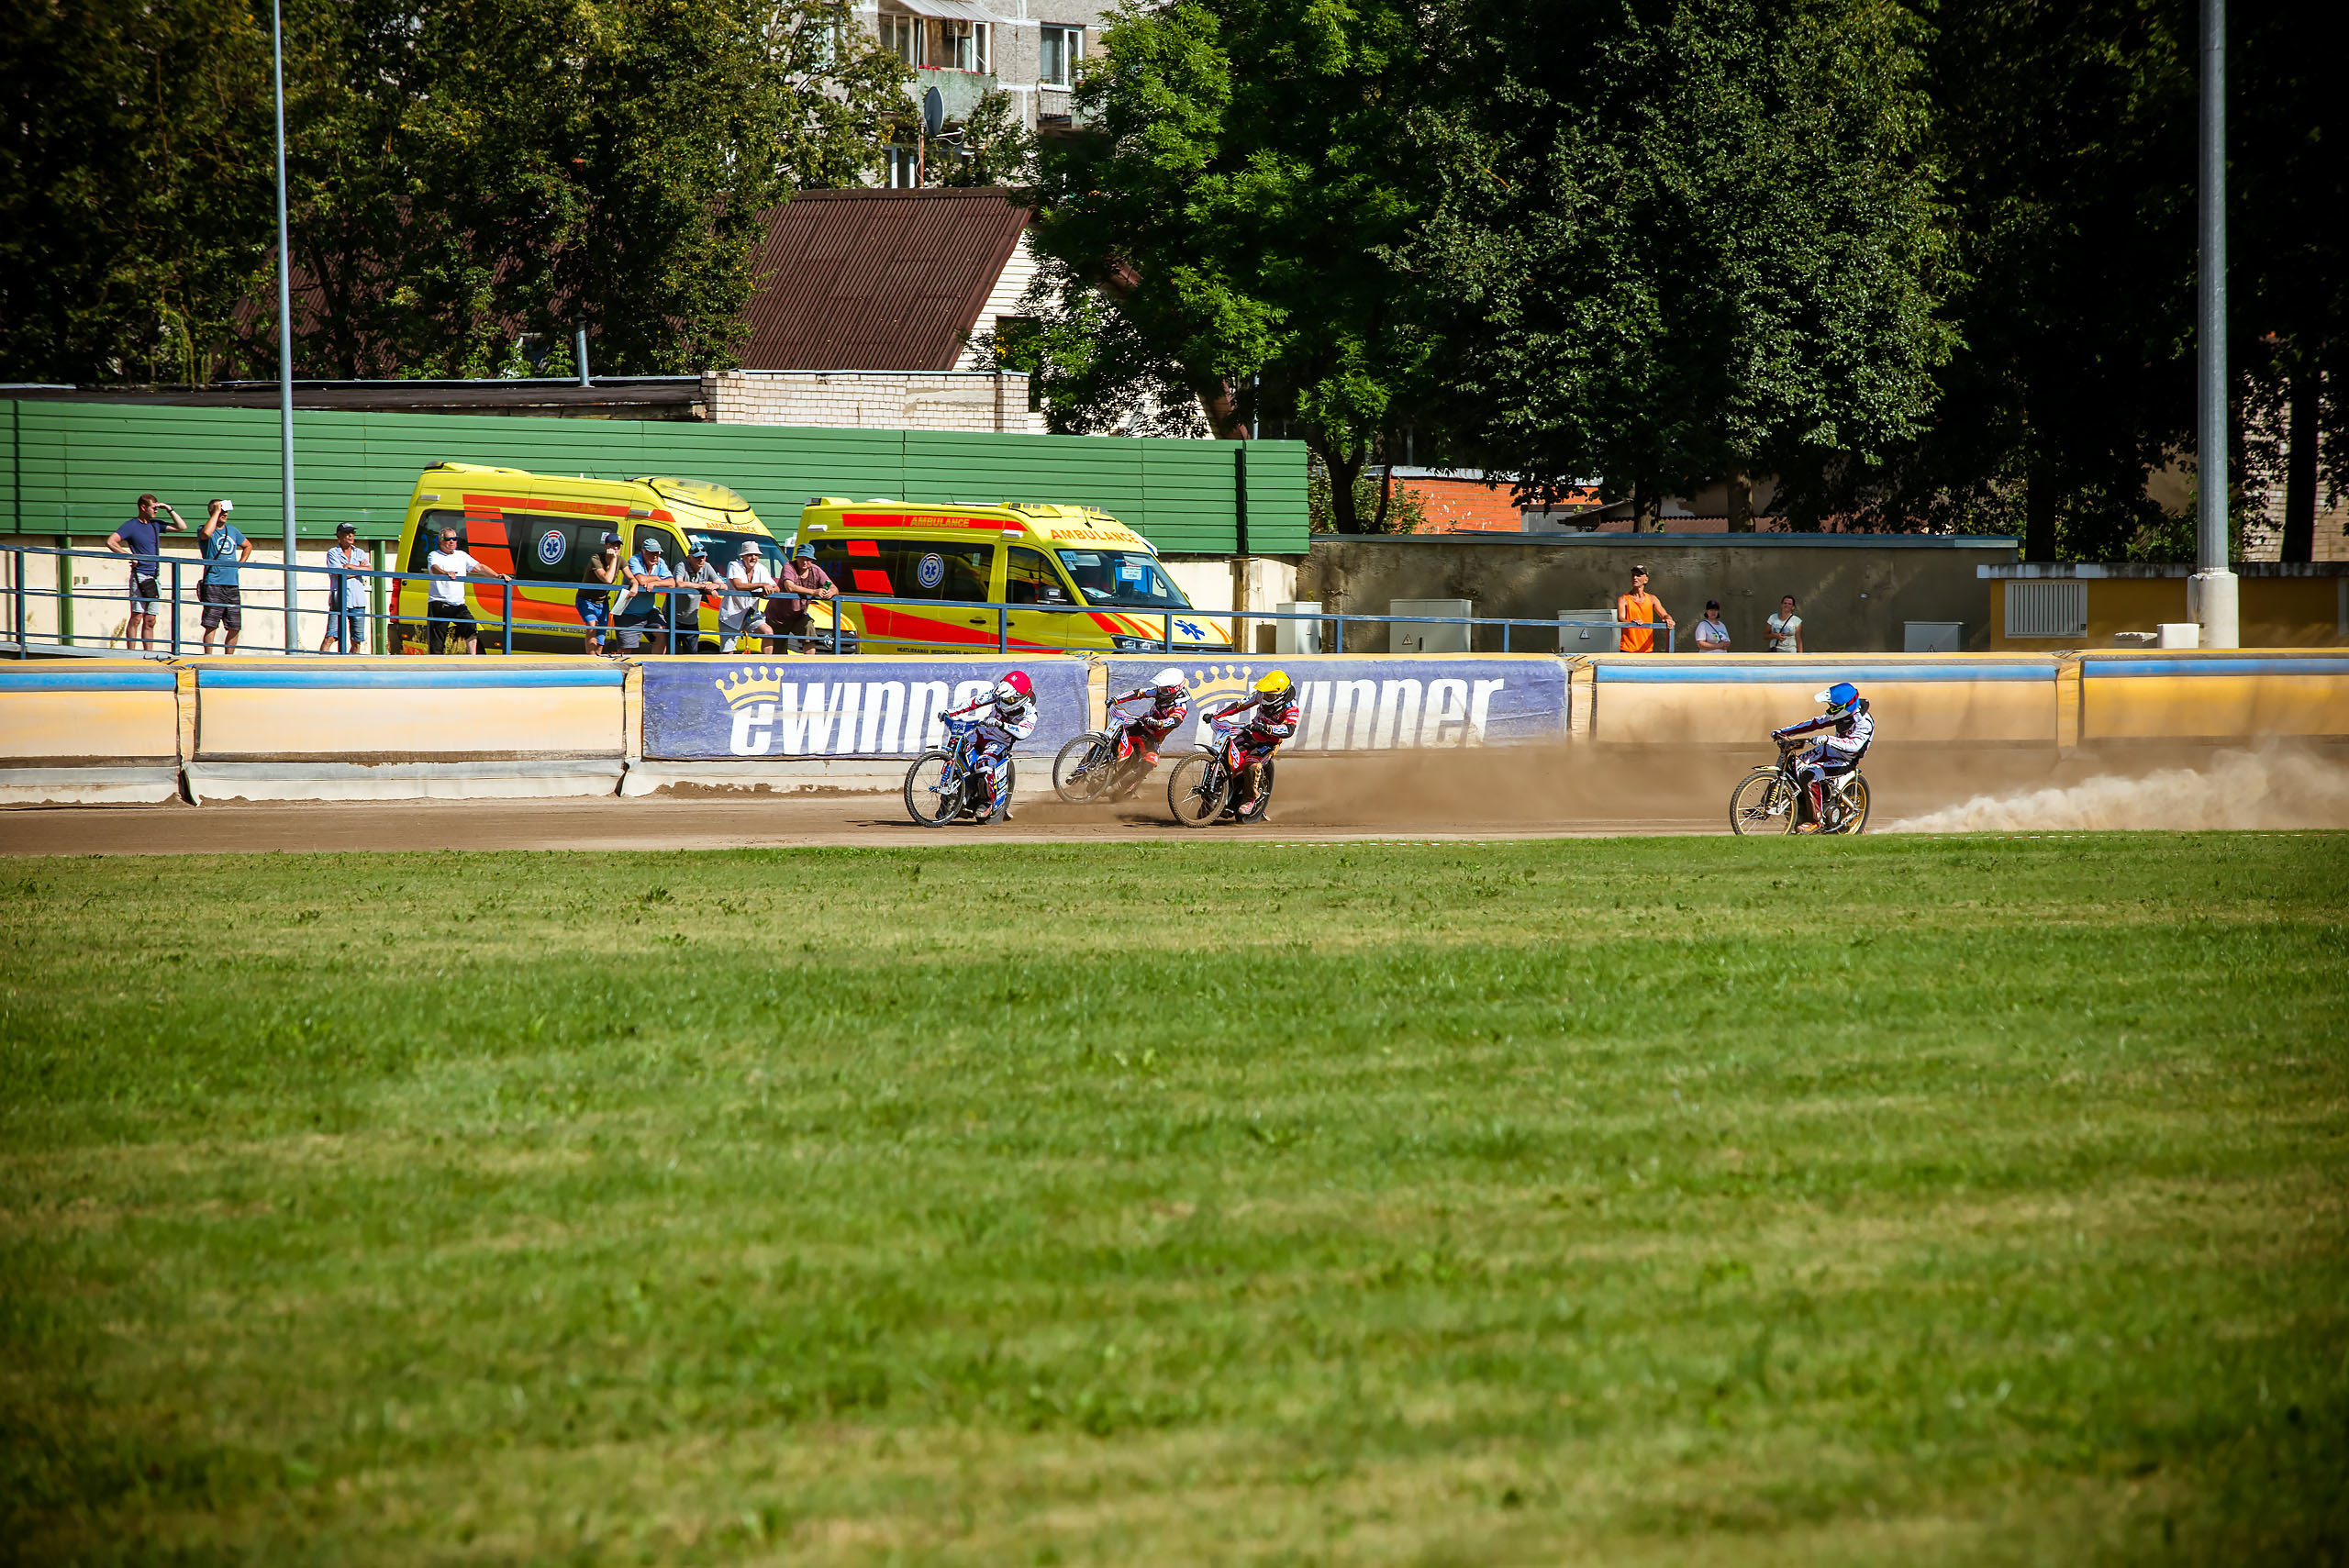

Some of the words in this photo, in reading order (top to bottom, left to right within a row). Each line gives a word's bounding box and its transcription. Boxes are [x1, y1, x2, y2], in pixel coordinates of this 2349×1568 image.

[545, 500, 607, 515] AMBULANCE
[706, 522, 758, 534] AMBULANCE
[910, 517, 970, 528] AMBULANCE
[1050, 528, 1140, 544] AMBULANCE
[729, 680, 995, 756] ewinne
